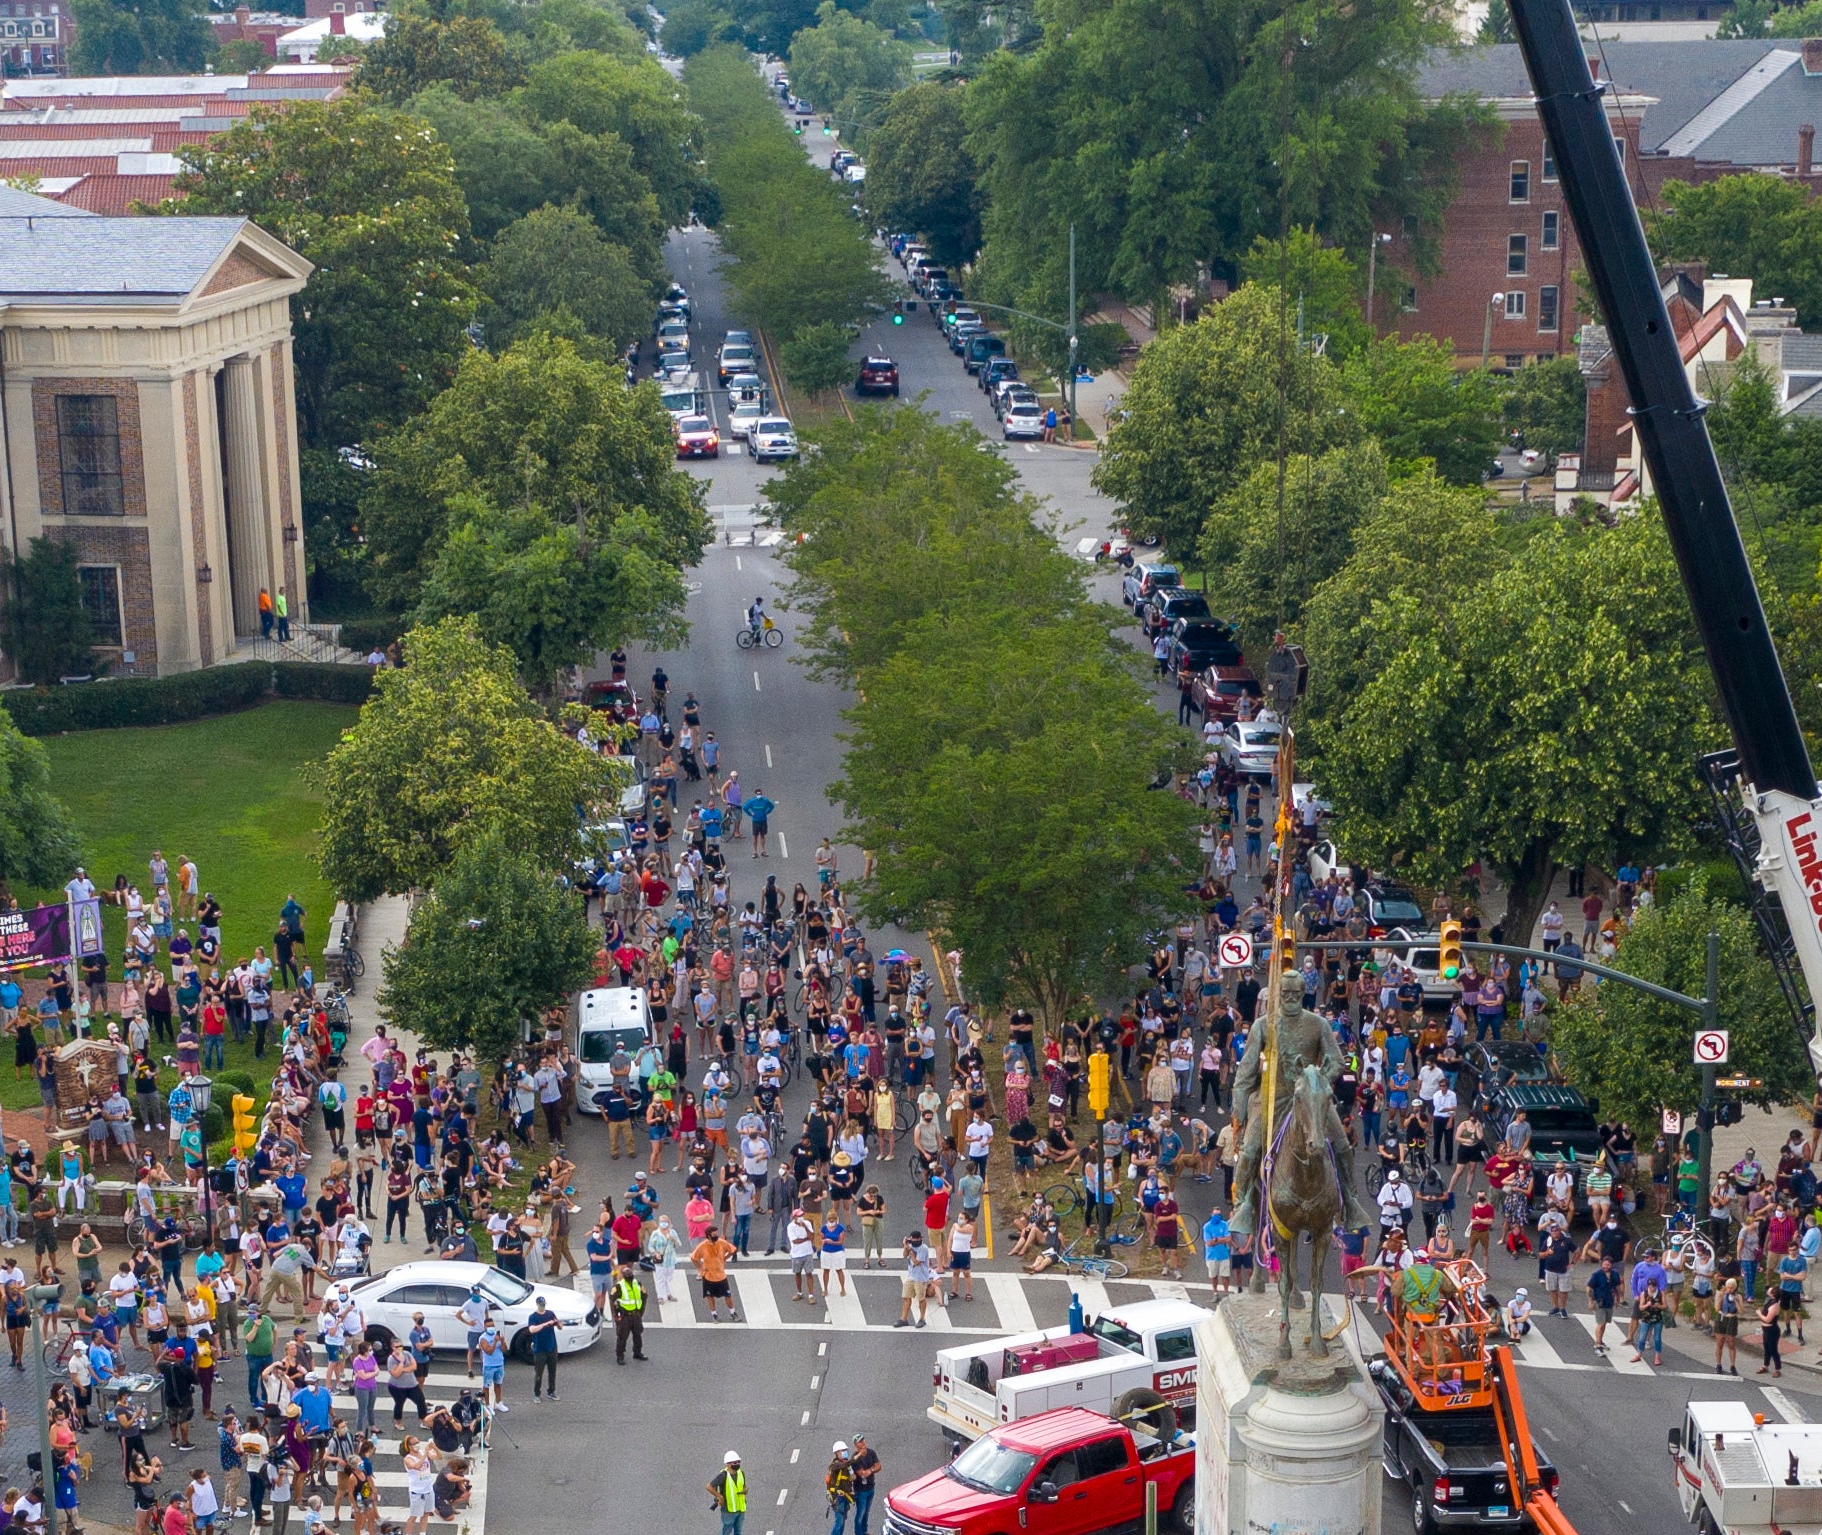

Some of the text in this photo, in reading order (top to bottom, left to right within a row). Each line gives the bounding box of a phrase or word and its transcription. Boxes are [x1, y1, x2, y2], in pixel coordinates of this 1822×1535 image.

[0, 922, 29, 935] THESE
[7, 930, 36, 944] HERE
[5, 943, 29, 956] YOU
[1445, 1394, 1472, 1406] JLG
